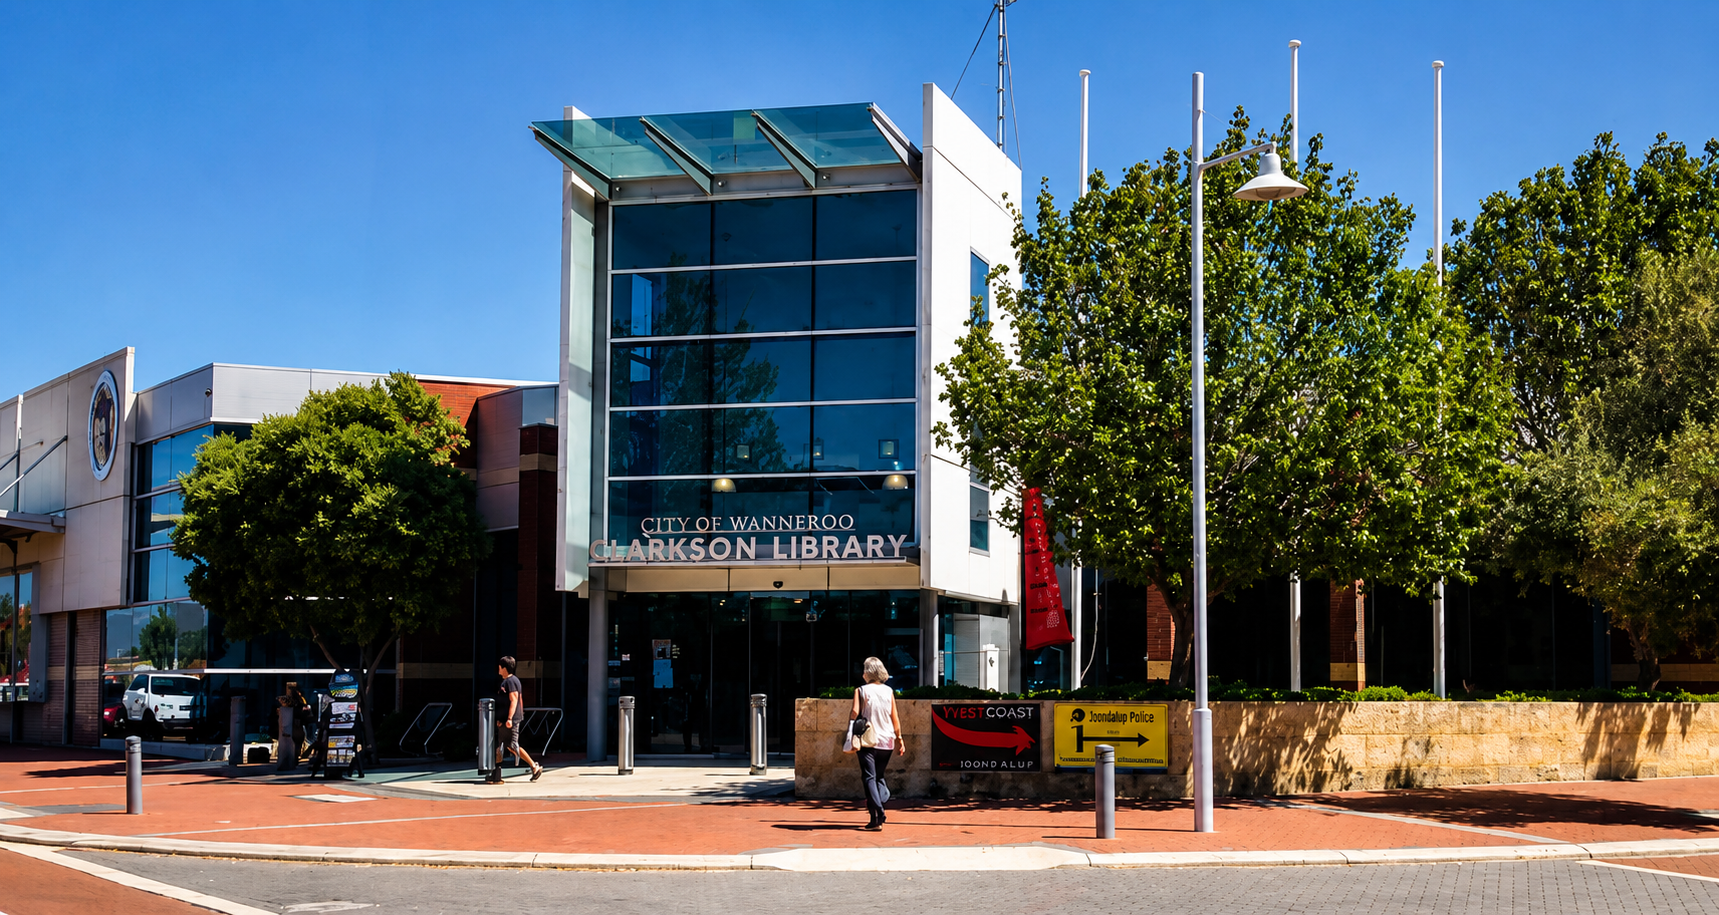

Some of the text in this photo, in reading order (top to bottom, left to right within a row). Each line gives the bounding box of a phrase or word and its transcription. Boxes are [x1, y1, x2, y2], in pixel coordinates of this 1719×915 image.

[641, 514, 854, 534] CITY OF WANNEROO
[589, 534, 908, 562] CLARKSON LIBRARY
[1089, 710, 1155, 725] Joondalup Police
